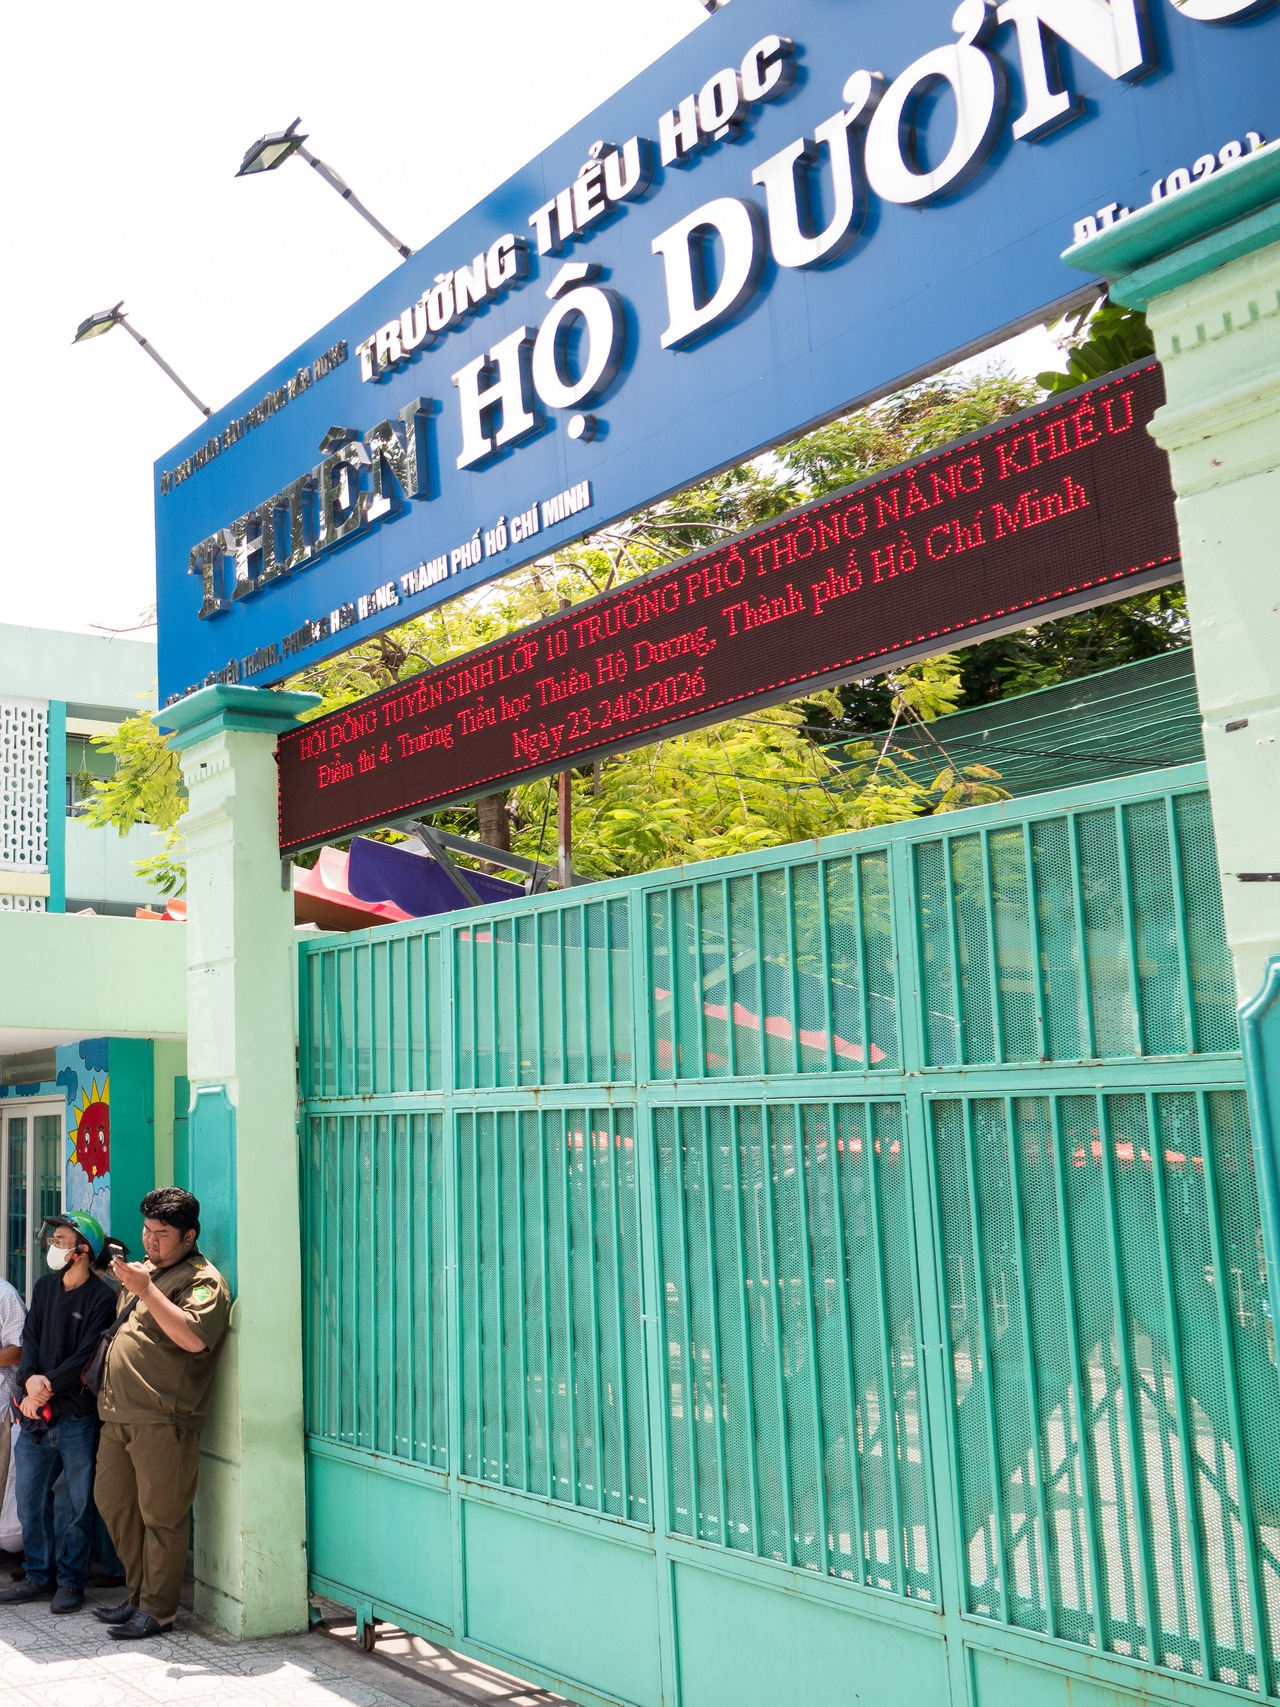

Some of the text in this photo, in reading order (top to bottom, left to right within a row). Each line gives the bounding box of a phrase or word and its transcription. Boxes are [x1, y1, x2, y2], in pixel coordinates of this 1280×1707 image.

[188, 0, 1265, 621] THIÊN HỘ DƯƠN
[355, 34, 794, 382] TRƯỜNG TIỂU HỌC
[357, 745, 377, 774] thi
[456, 696, 497, 735] Tiểu
[499, 694, 532, 722] học
[535, 667, 592, 707] Thiên
[595, 650, 628, 684] Hộ
[721, 583, 806, 637] Thành
[810, 548, 863, 616] phố
[870, 530, 917, 584] Hồ
[924, 511, 986, 561] Chí
[990, 475, 1090, 540] Minh
[401, 554, 450, 598] THÀNH
[451, 528, 483, 574] PHỐ
[485, 516, 509, 557] HỒ
[510, 502, 541, 543] CHÍ
[542, 480, 593, 528] MINH
[446, 658, 495, 701] SINH
[497, 638, 539, 682] LỚP
[546, 629, 569, 661] 10
[994, 390, 1134, 480] KHIẾU
[512, 666, 706, 761] Ngày 23-24/5/2026
